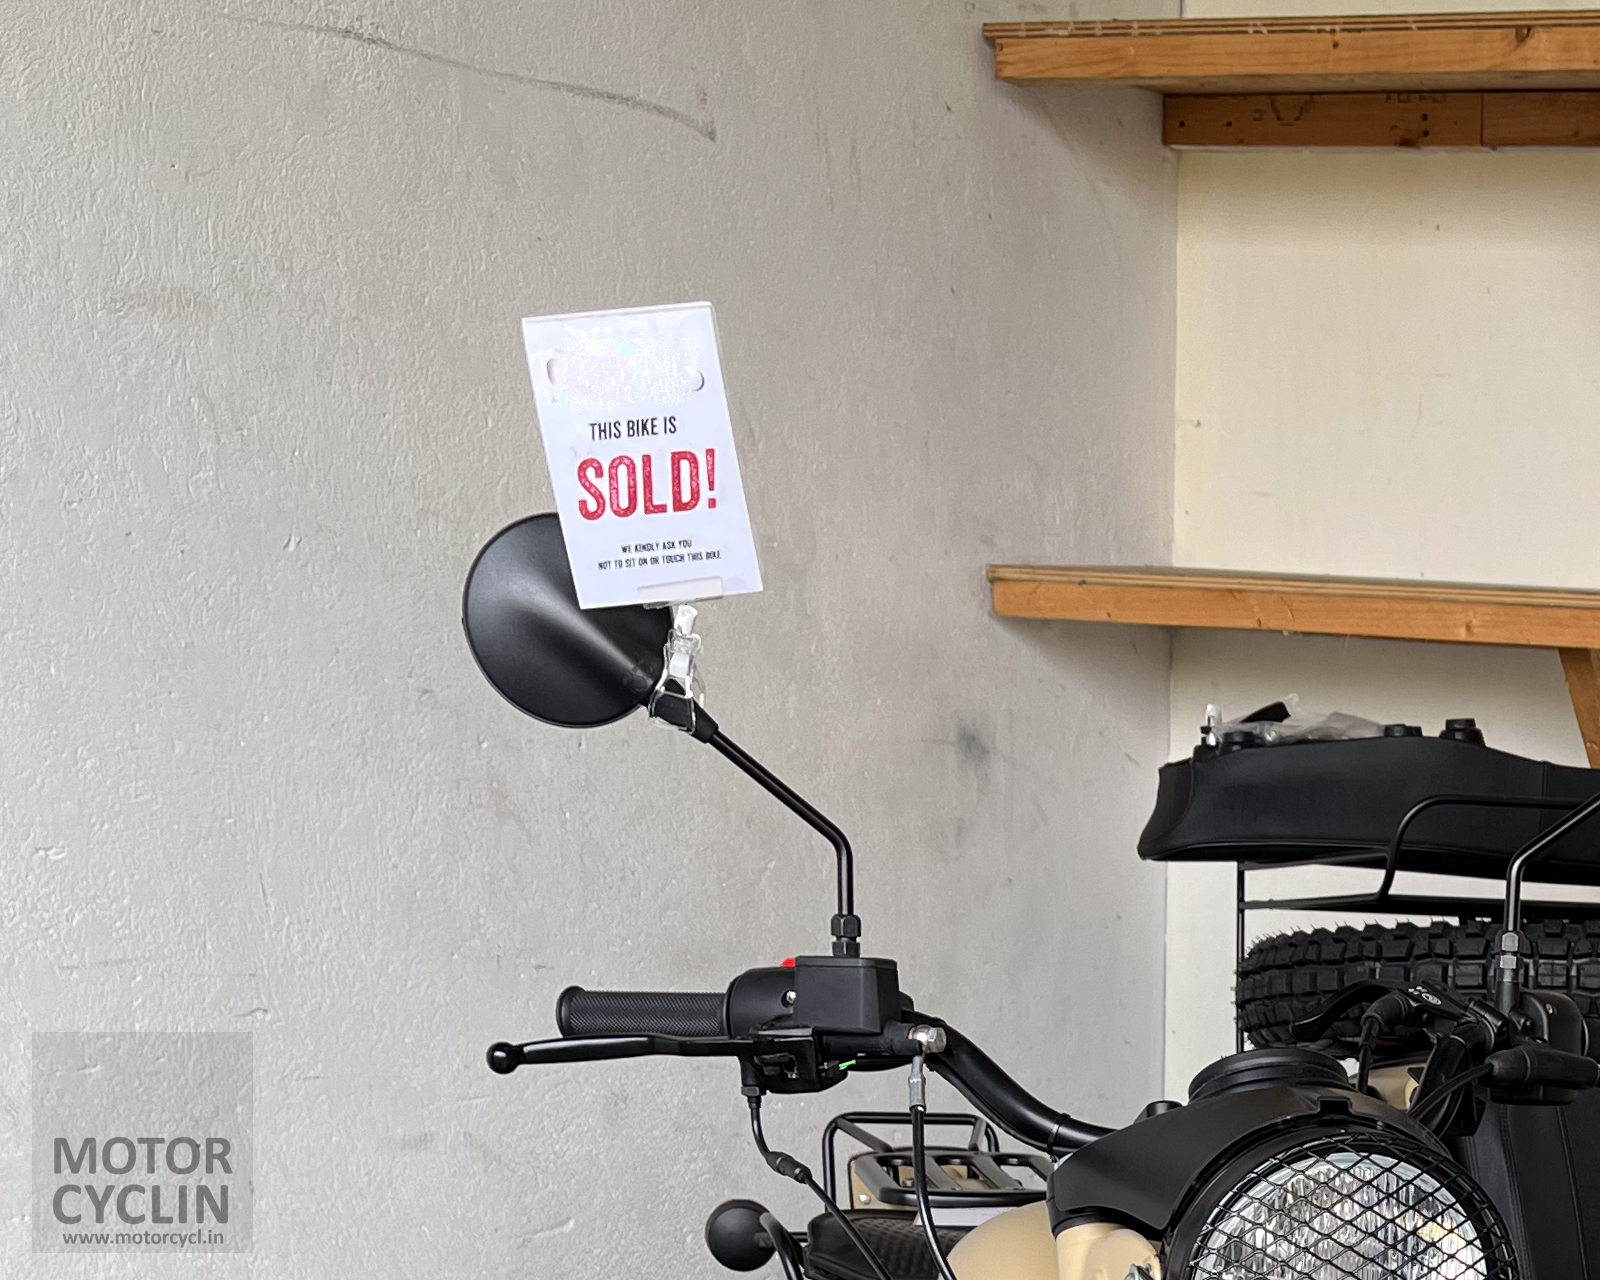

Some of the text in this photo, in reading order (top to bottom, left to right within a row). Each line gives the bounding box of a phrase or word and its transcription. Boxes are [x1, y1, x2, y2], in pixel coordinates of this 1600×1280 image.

[589, 415, 677, 441] THIS BIKE IS
[577, 448, 717, 521] SOLD!
[621, 539, 693, 554] WE KINDLY ASK YOU
[598, 550, 722, 571] NOT TO SIT ON OR TOUCH THIS BIKE
